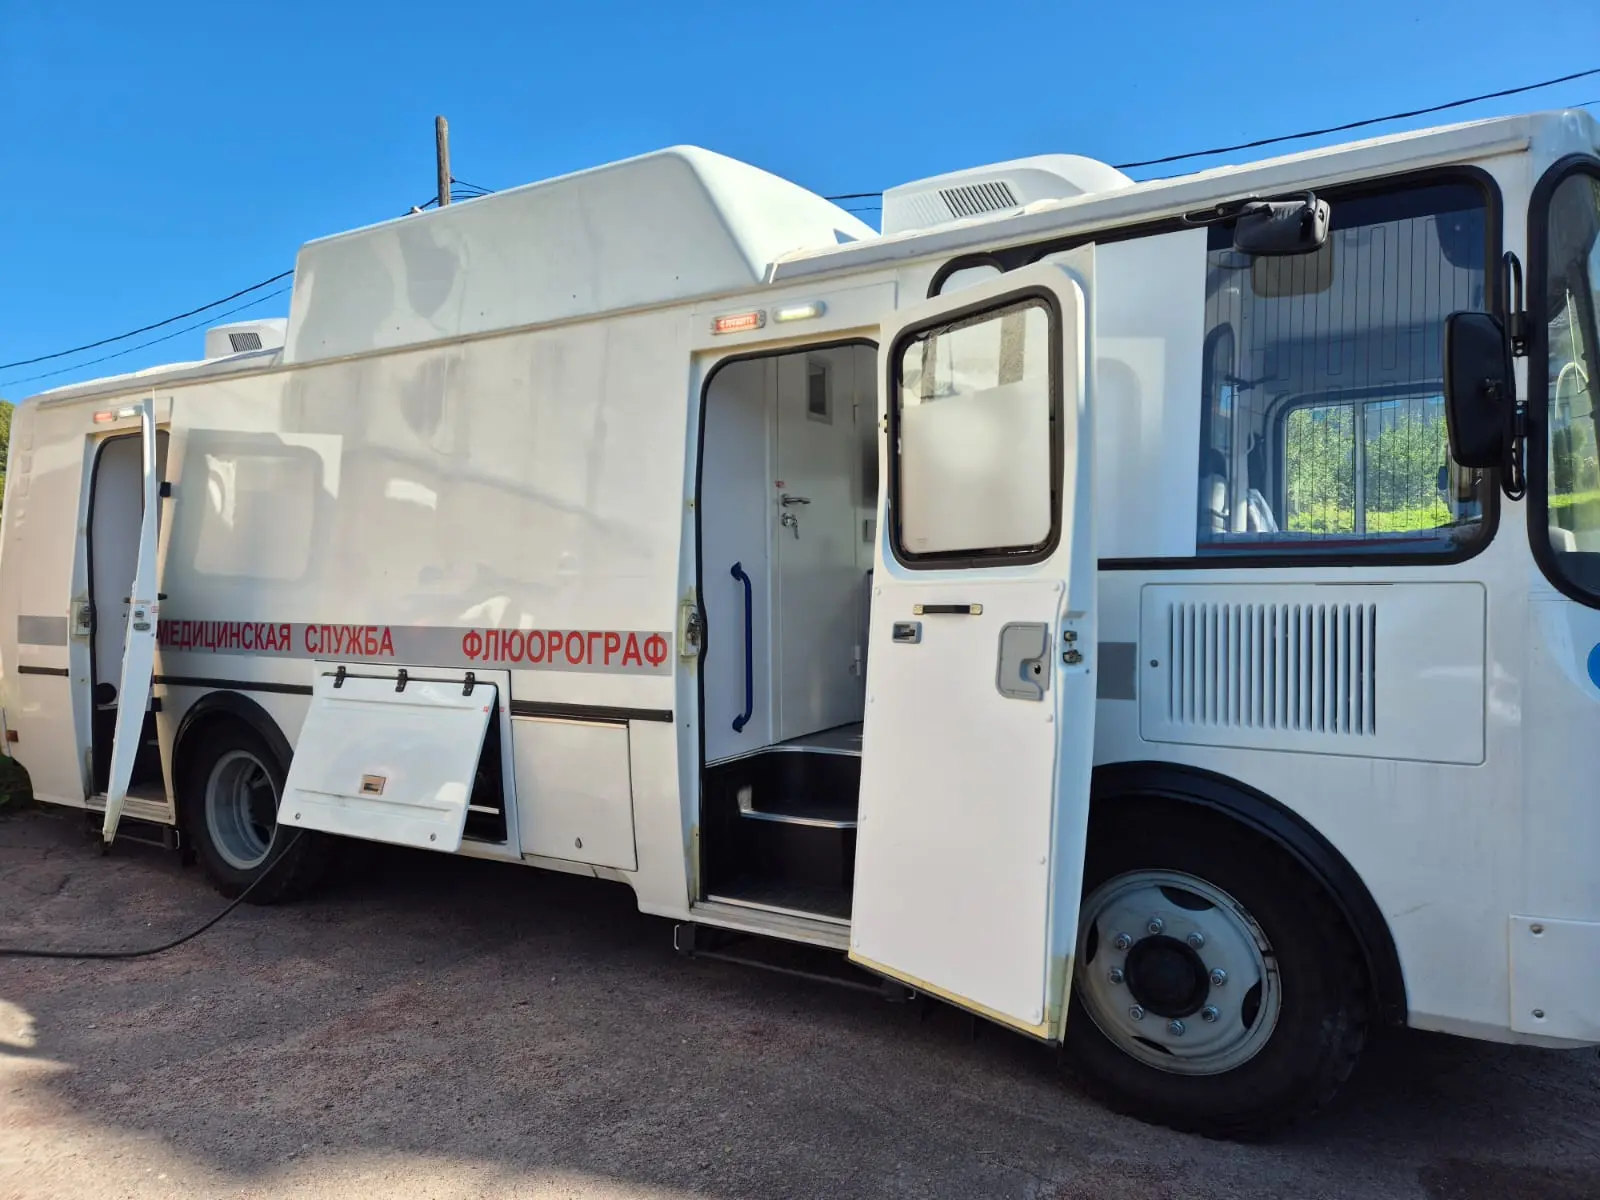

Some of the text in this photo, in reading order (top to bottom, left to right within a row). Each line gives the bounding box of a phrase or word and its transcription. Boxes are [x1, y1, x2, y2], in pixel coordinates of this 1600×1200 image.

[157, 620, 395, 656] МЕДИЦИНСКАЯ СЛУЖБА
[462, 629, 668, 667] ФЛЮОРОГРАФ
